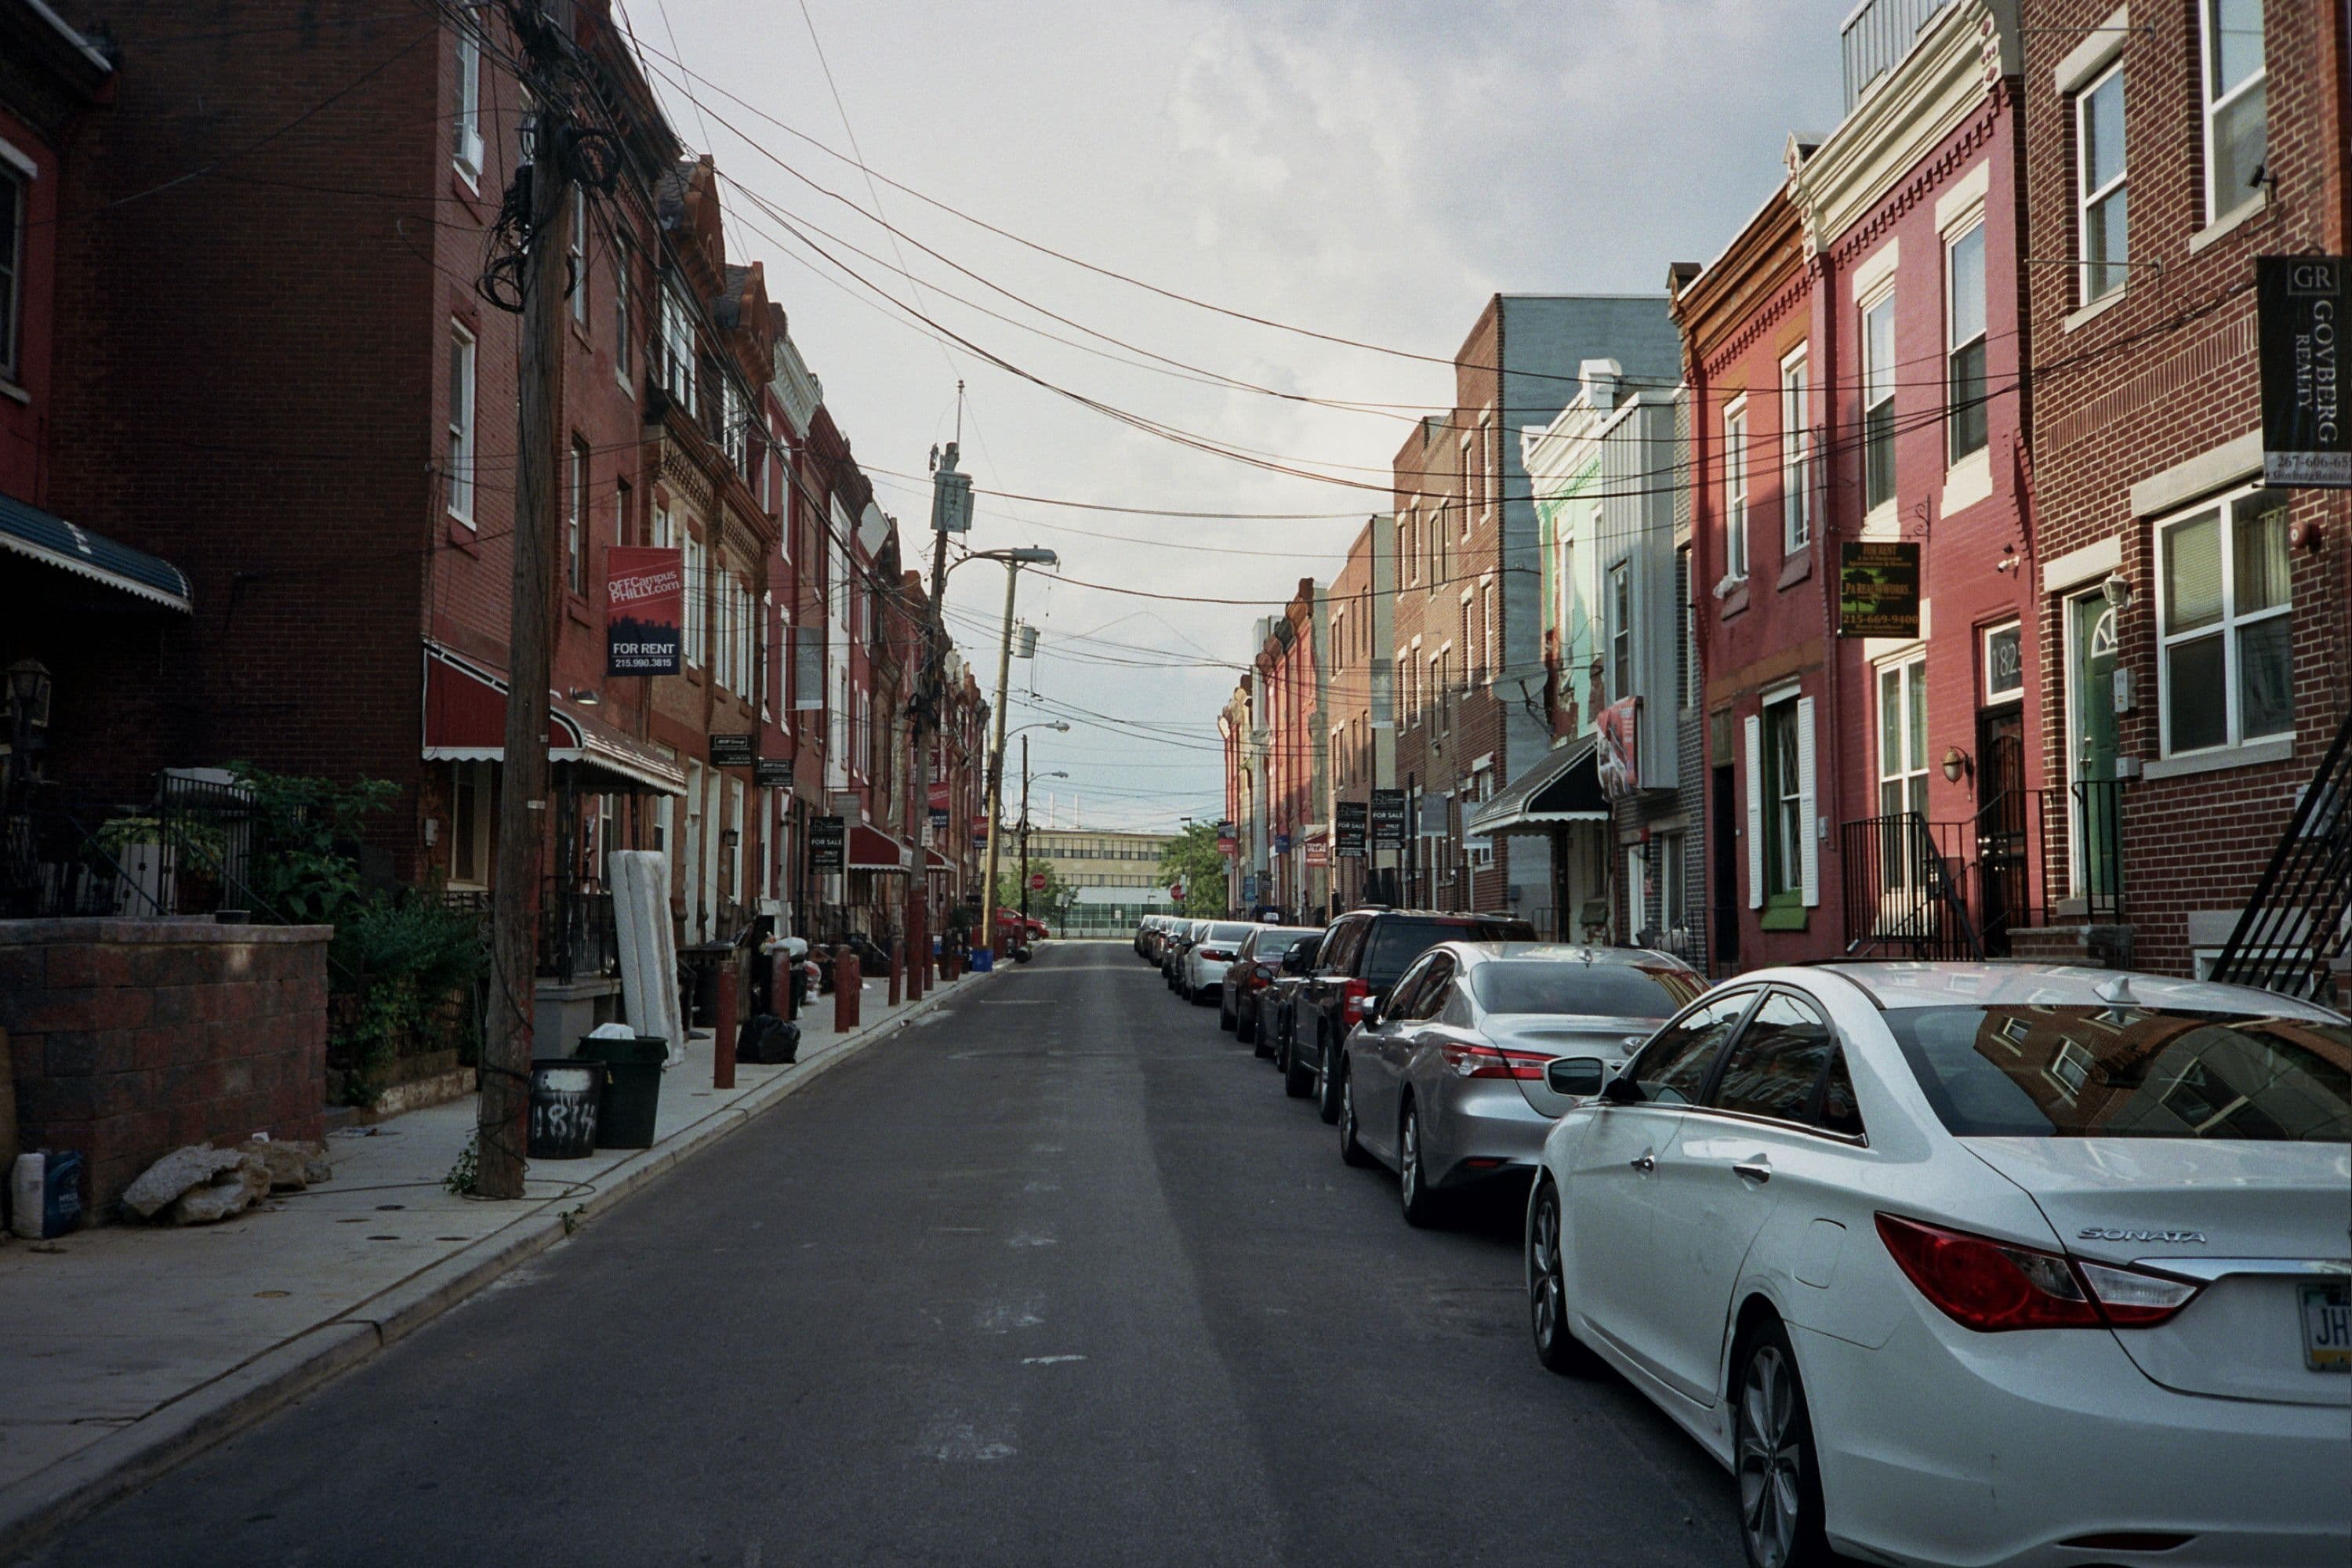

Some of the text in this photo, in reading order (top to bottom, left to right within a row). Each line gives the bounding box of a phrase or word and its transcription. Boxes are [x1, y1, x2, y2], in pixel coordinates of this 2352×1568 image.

[2293, 266, 2332, 289] GR
[2296, 333, 2312, 411] REALTY
[2314, 299, 2338, 444] GOVBERG
[2278, 456, 2350, 468] 267-606-65
[611, 581, 680, 603] PHILLY.com
[1843, 615, 1918, 624] 215-669-9400
[613, 643, 675, 654] FOR RENT
[615, 659, 672, 667] 215.990.3815
[2078, 1228, 2207, 1243] SONATA
